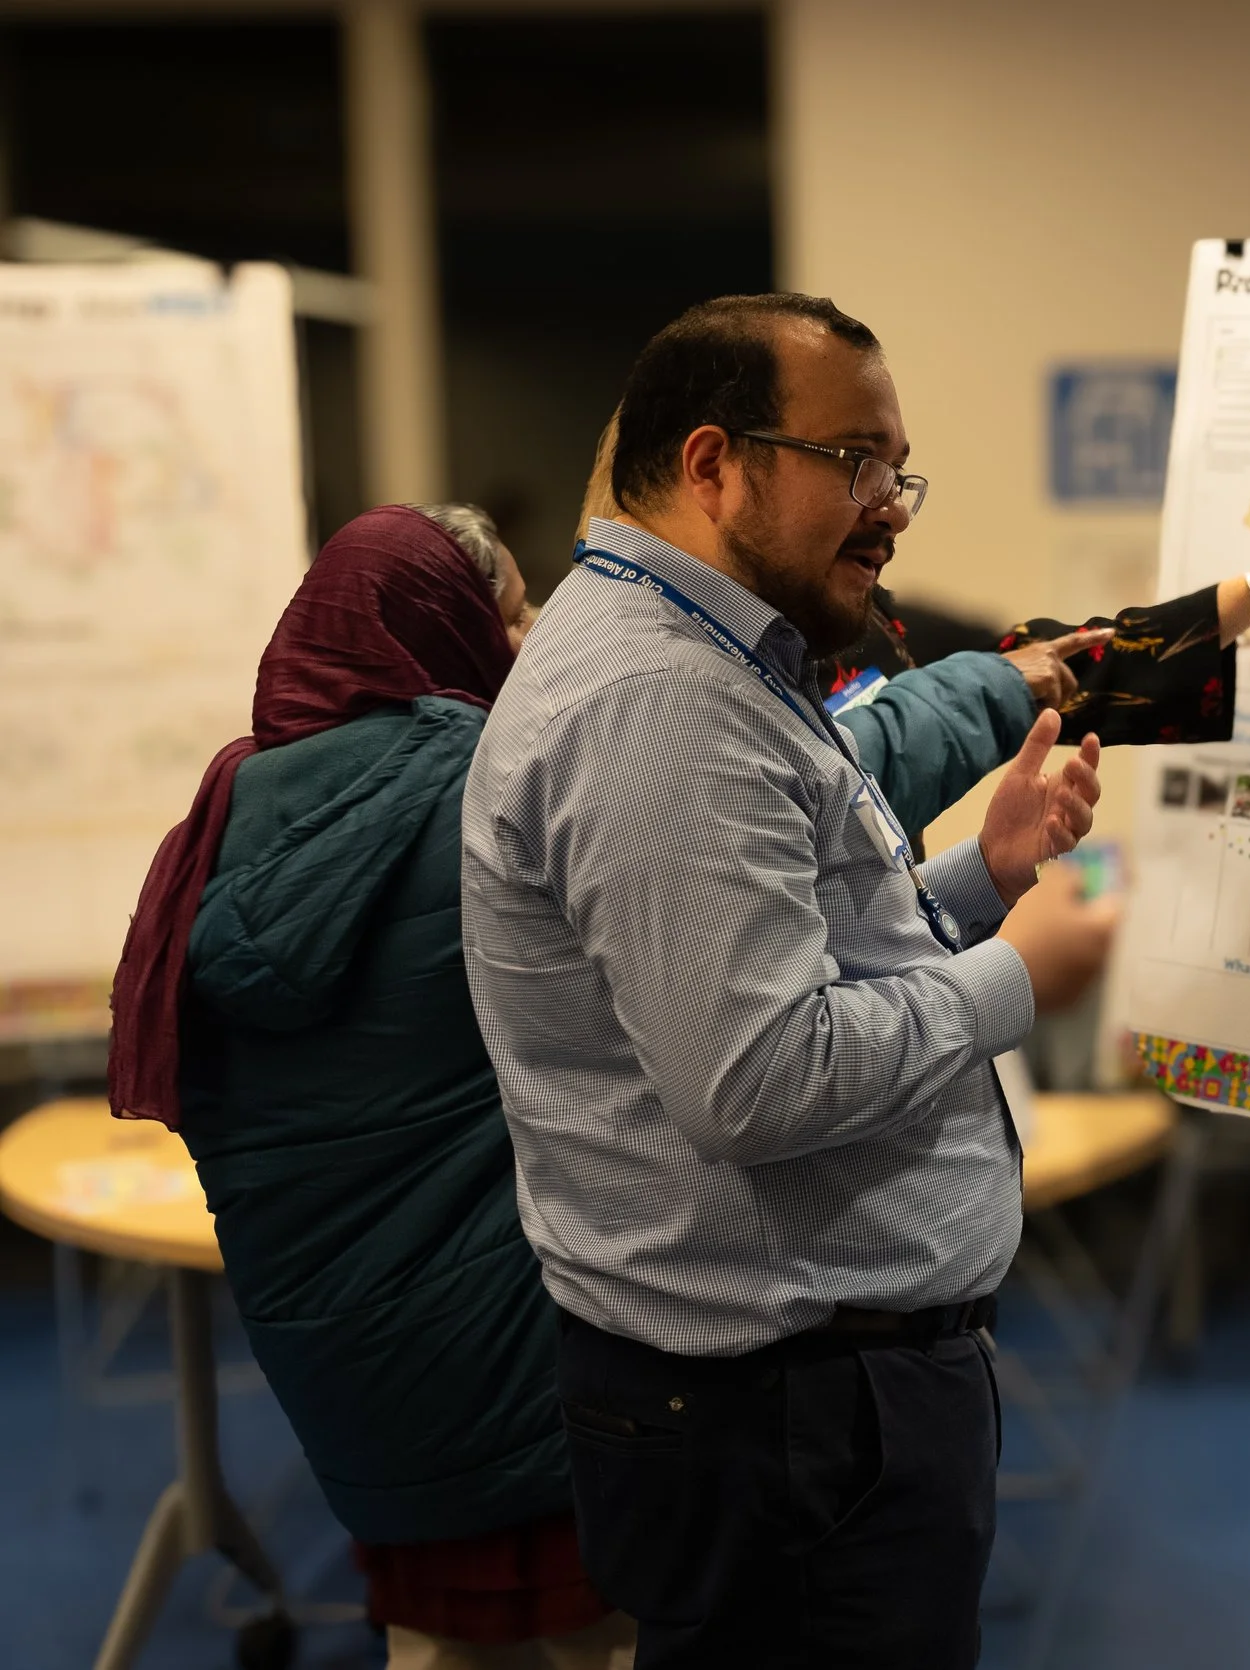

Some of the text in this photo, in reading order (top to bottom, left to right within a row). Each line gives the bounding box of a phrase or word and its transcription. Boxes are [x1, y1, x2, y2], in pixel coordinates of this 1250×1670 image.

[584, 554, 664, 594] City of Alexandr
[691, 611, 751, 667] Alexandria
